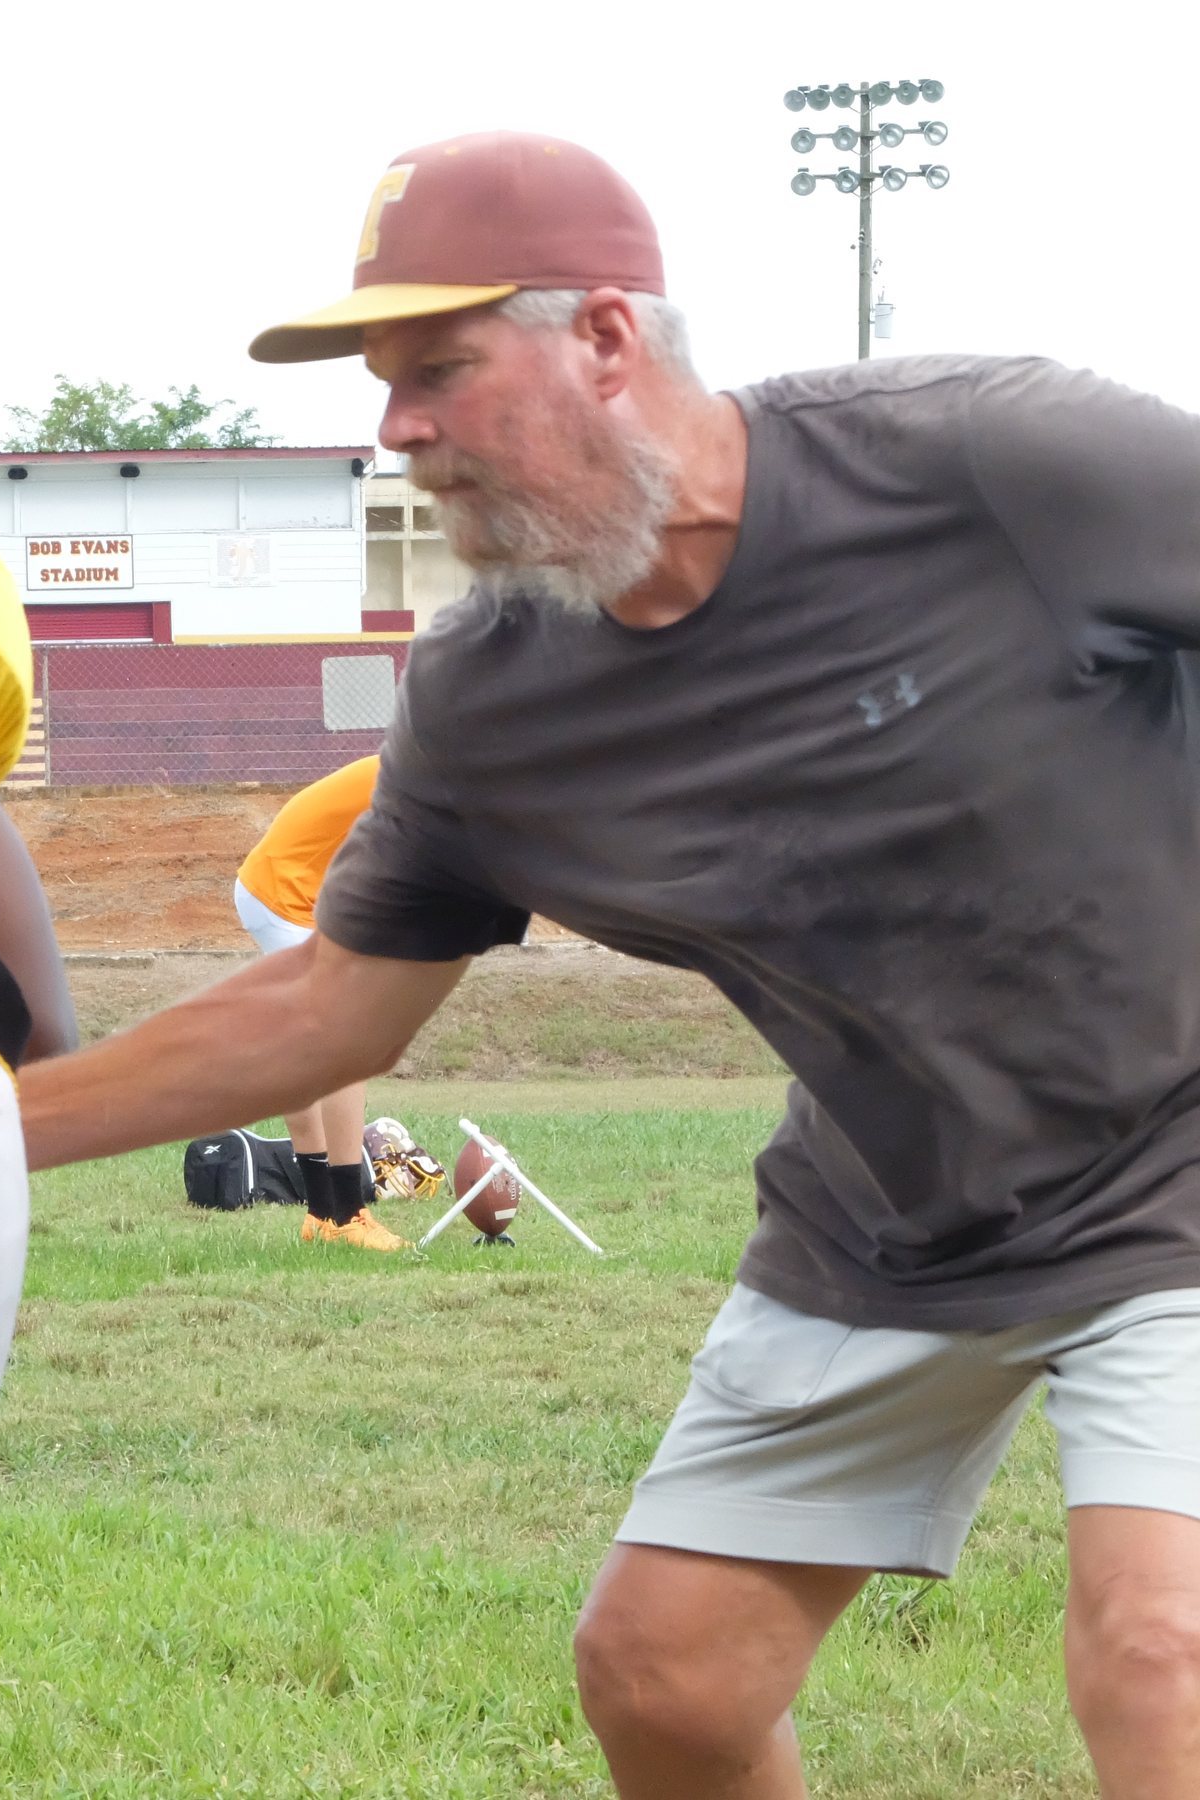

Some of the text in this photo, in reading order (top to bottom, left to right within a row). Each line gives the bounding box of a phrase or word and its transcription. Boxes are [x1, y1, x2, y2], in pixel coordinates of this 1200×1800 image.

[29, 540, 130, 555] BOB EVANS
[40, 567, 119, 582] STADIUM
